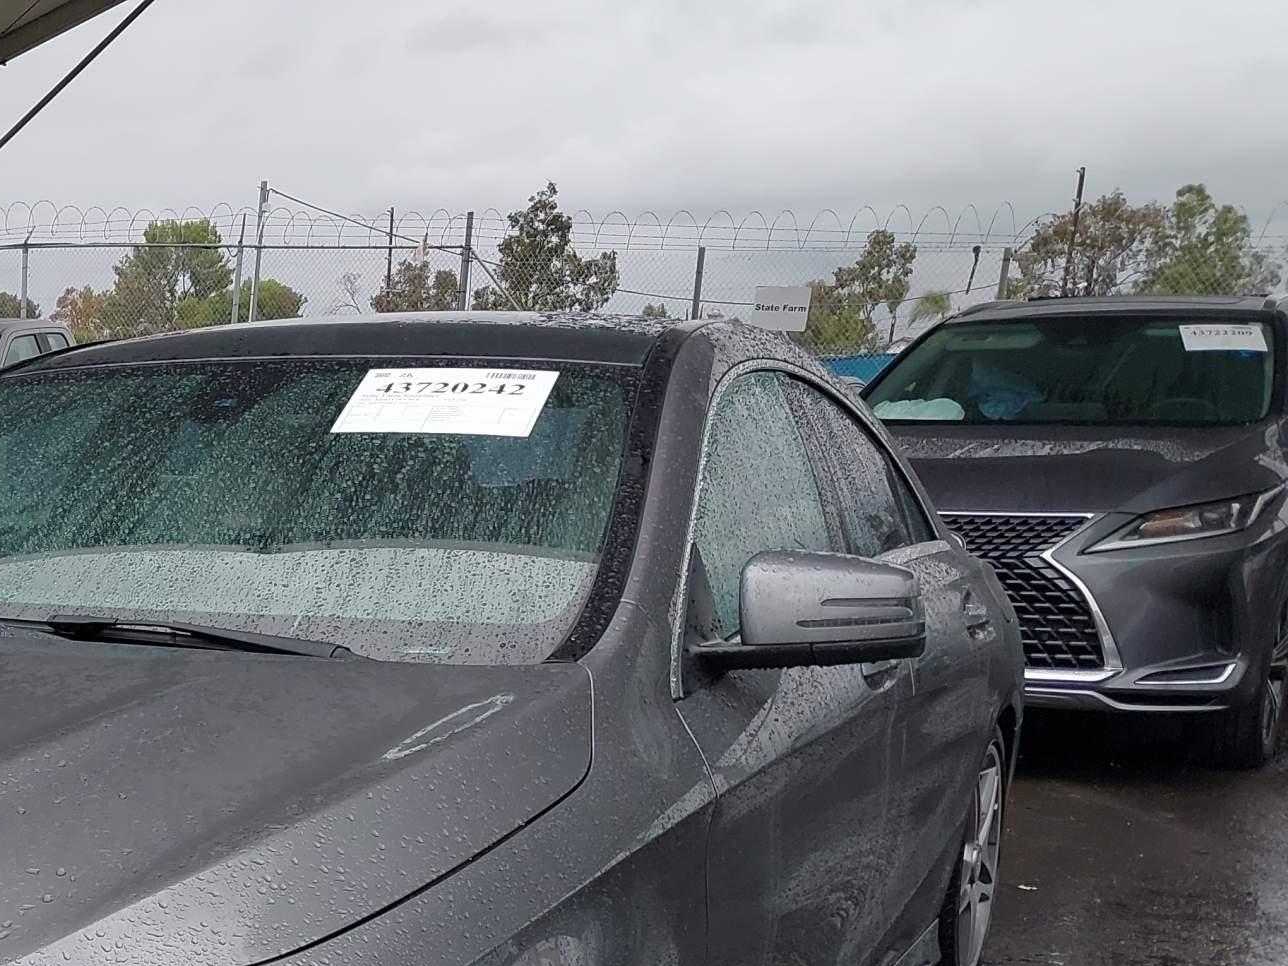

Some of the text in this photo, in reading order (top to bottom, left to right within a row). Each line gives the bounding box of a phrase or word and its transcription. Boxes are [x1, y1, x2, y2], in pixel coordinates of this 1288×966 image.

[754, 303, 807, 313] State Farm
[376, 381, 526, 396] 43720242
